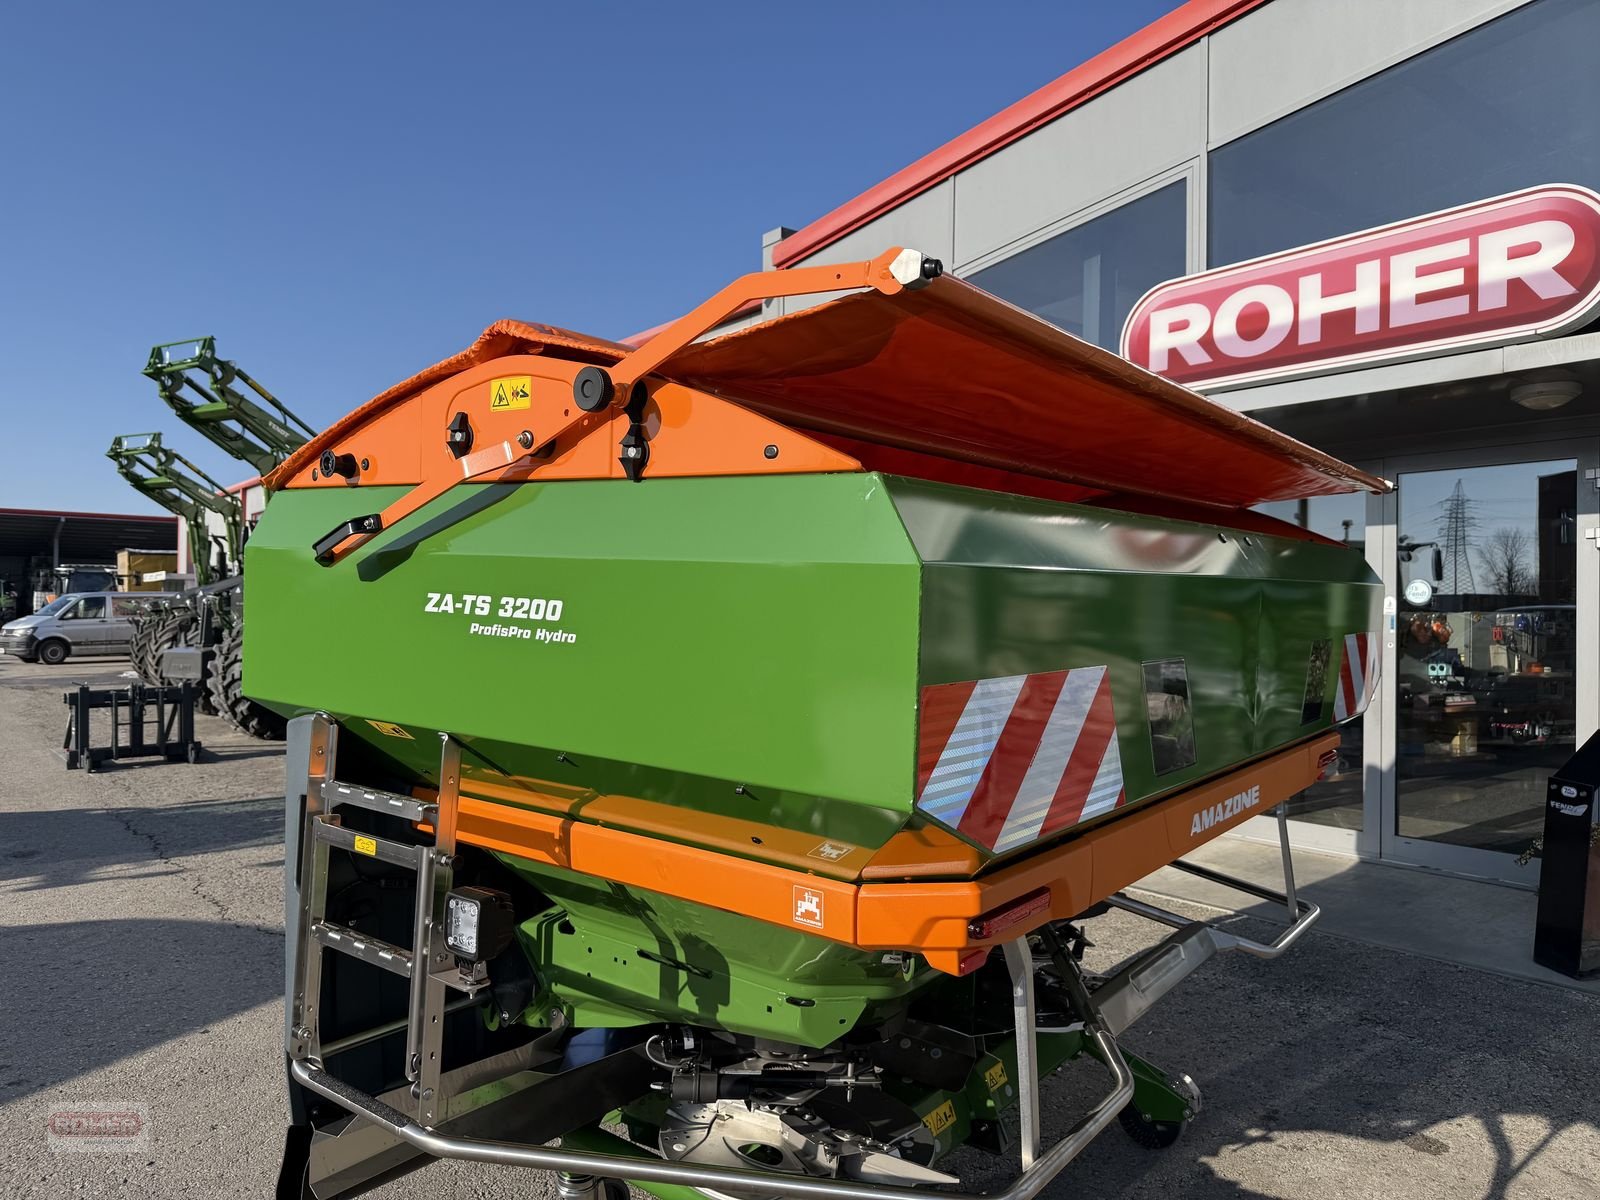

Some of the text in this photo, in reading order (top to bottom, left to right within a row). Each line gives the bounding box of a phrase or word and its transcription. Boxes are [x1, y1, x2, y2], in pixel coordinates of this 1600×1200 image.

[1148, 220, 1580, 373] ROHER
[424, 592, 564, 621] ZA-TS 3200
[469, 622, 577, 644] ProfisPro Hydro
[1190, 784, 1260, 837] AMAZONE
